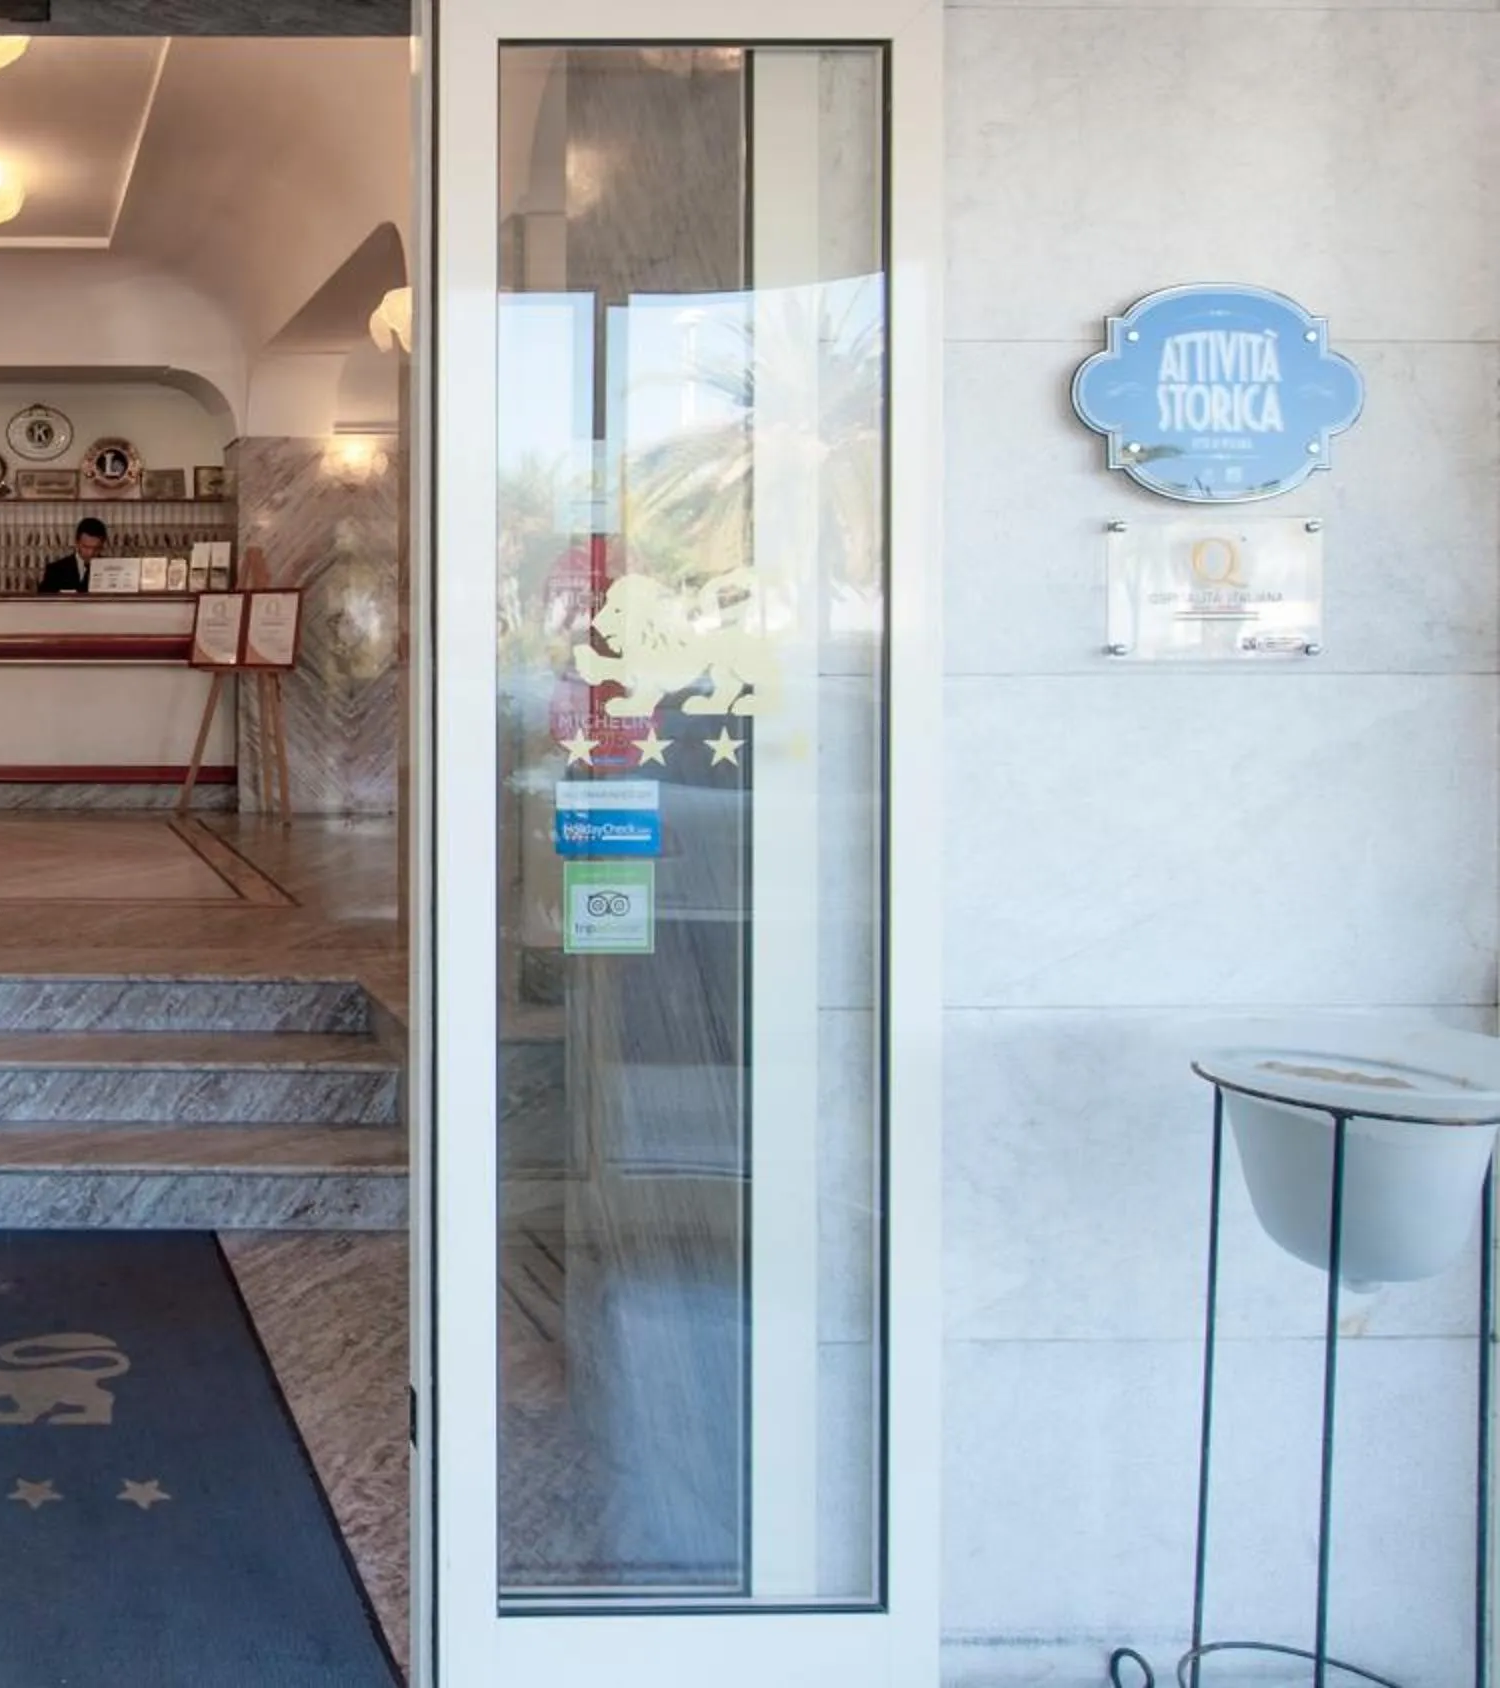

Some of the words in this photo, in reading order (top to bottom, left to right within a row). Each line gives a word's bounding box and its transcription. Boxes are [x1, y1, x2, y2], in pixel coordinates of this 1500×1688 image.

[1159, 328, 1283, 383] ATTIVITÀ
[1156, 383, 1285, 433] STORICA
[1191, 537, 1248, 589] Q
